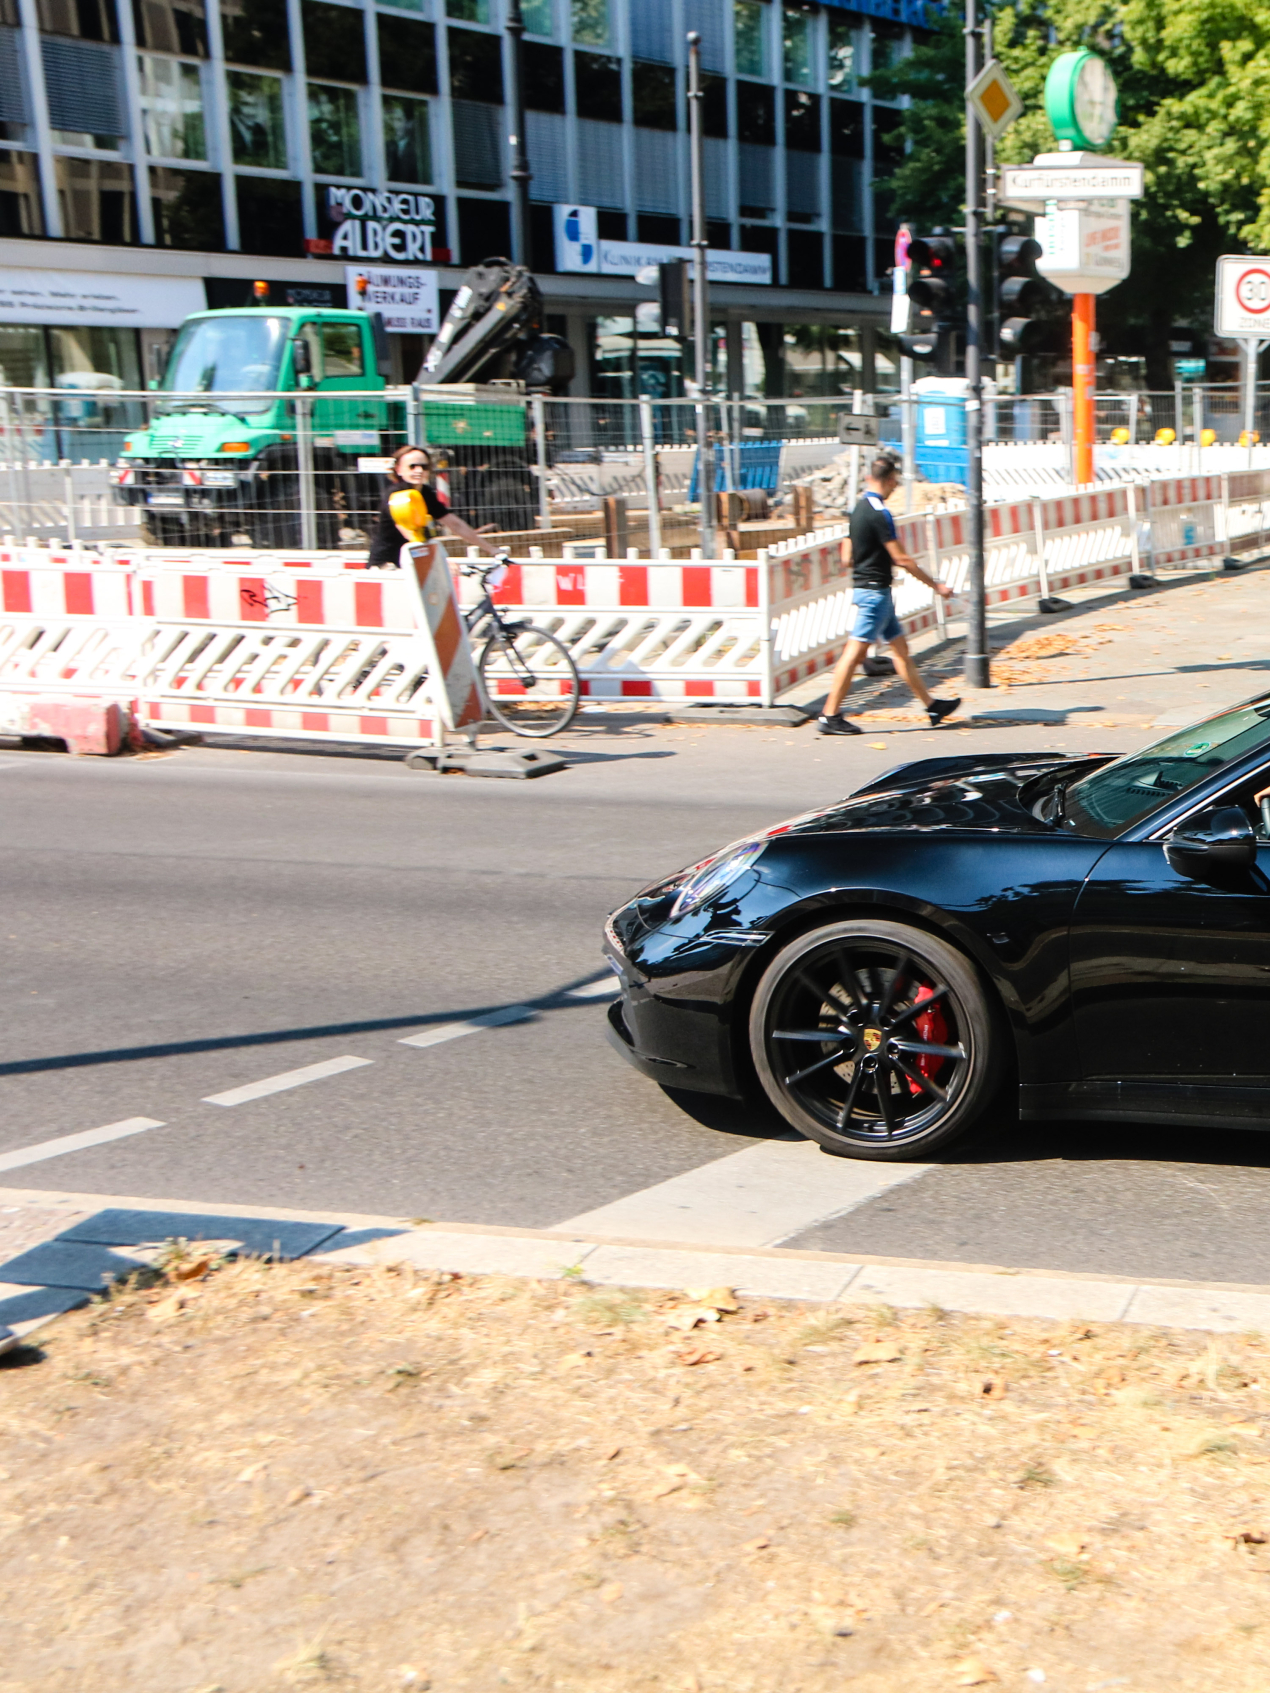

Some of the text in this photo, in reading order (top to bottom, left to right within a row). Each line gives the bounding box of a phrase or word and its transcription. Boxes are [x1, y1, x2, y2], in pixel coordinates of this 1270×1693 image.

[327, 186, 437, 221] MONSIEUR
[331, 219, 436, 262] ALBERT
[1244, 280, 1270, 301] 30
